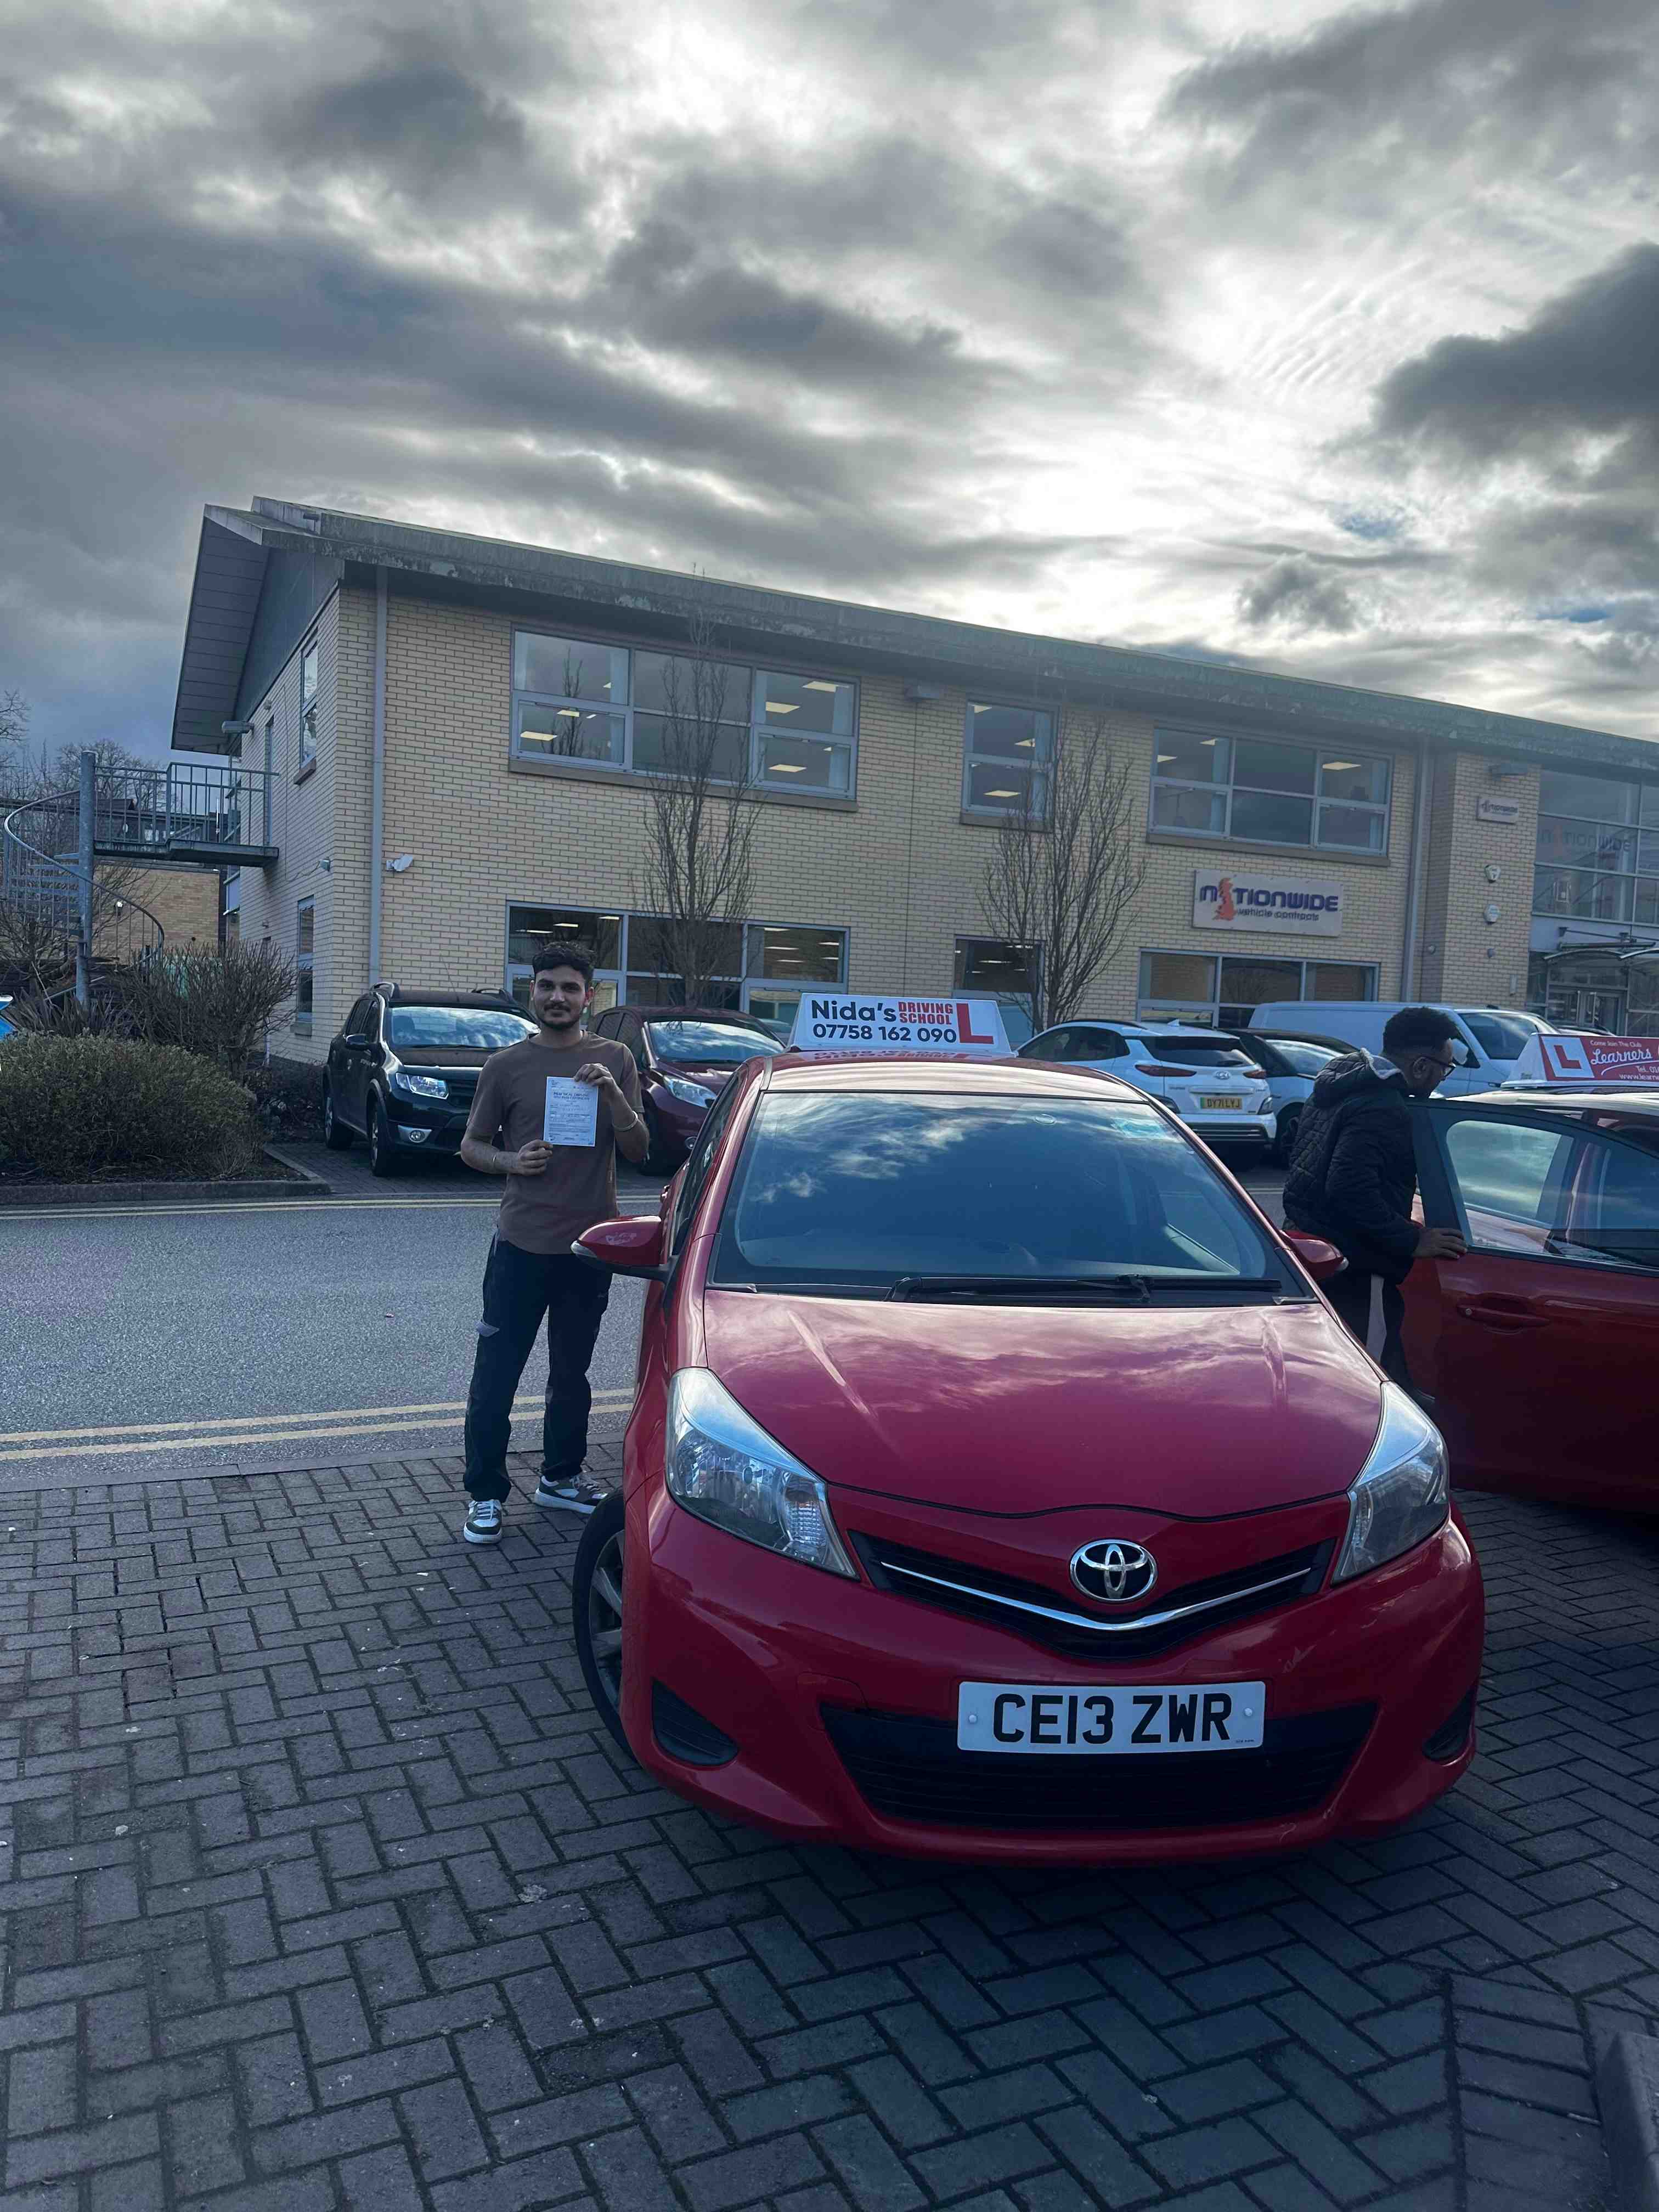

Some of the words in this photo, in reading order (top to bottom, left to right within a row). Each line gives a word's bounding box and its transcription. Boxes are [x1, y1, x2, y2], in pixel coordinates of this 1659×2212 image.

[1238, 908, 1273, 918] vehicle
[1274, 911, 1319, 921] contracts
[811, 1000, 897, 1022] Nida's
[899, 1001, 953, 1014] DRIVING
[899, 1013, 952, 1025] SCHOOL
[956, 1003, 994, 1045] L
[812, 1024, 873, 1040] 07758
[879, 1026, 911, 1041] 162
[917, 1028, 957, 1043] 090
[1553, 1045, 1582, 1069] L
[1590, 1048, 1653, 1065] Learners
[993, 1693, 1114, 1745] CE13
[1131, 1692, 1232, 1744] ZWR
